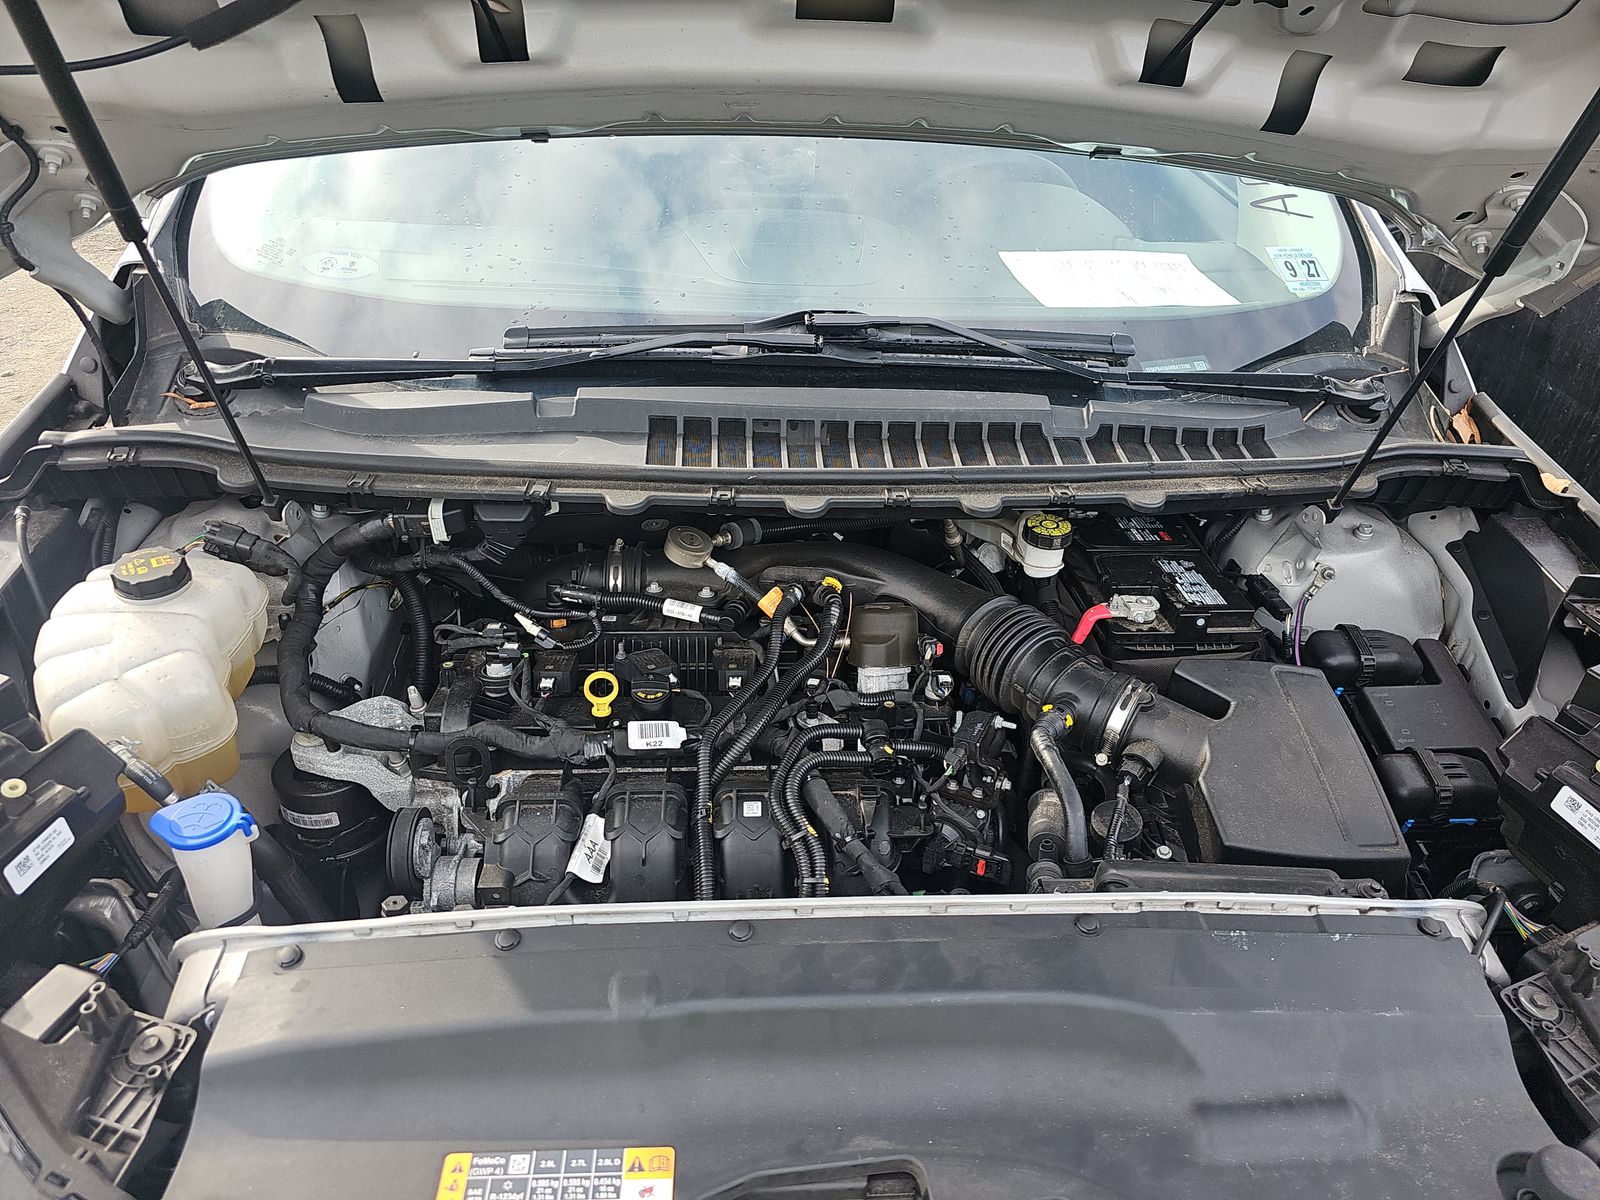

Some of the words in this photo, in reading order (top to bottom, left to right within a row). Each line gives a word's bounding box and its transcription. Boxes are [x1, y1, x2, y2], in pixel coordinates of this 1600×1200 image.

[1249, 193, 1315, 219] A
[1283, 260, 1298, 278] 9
[1300, 259, 1321, 278] 27
[645, 740, 664, 748] K22
[584, 840, 600, 864] AAA
[472, 1156, 506, 1165] FoMoCo
